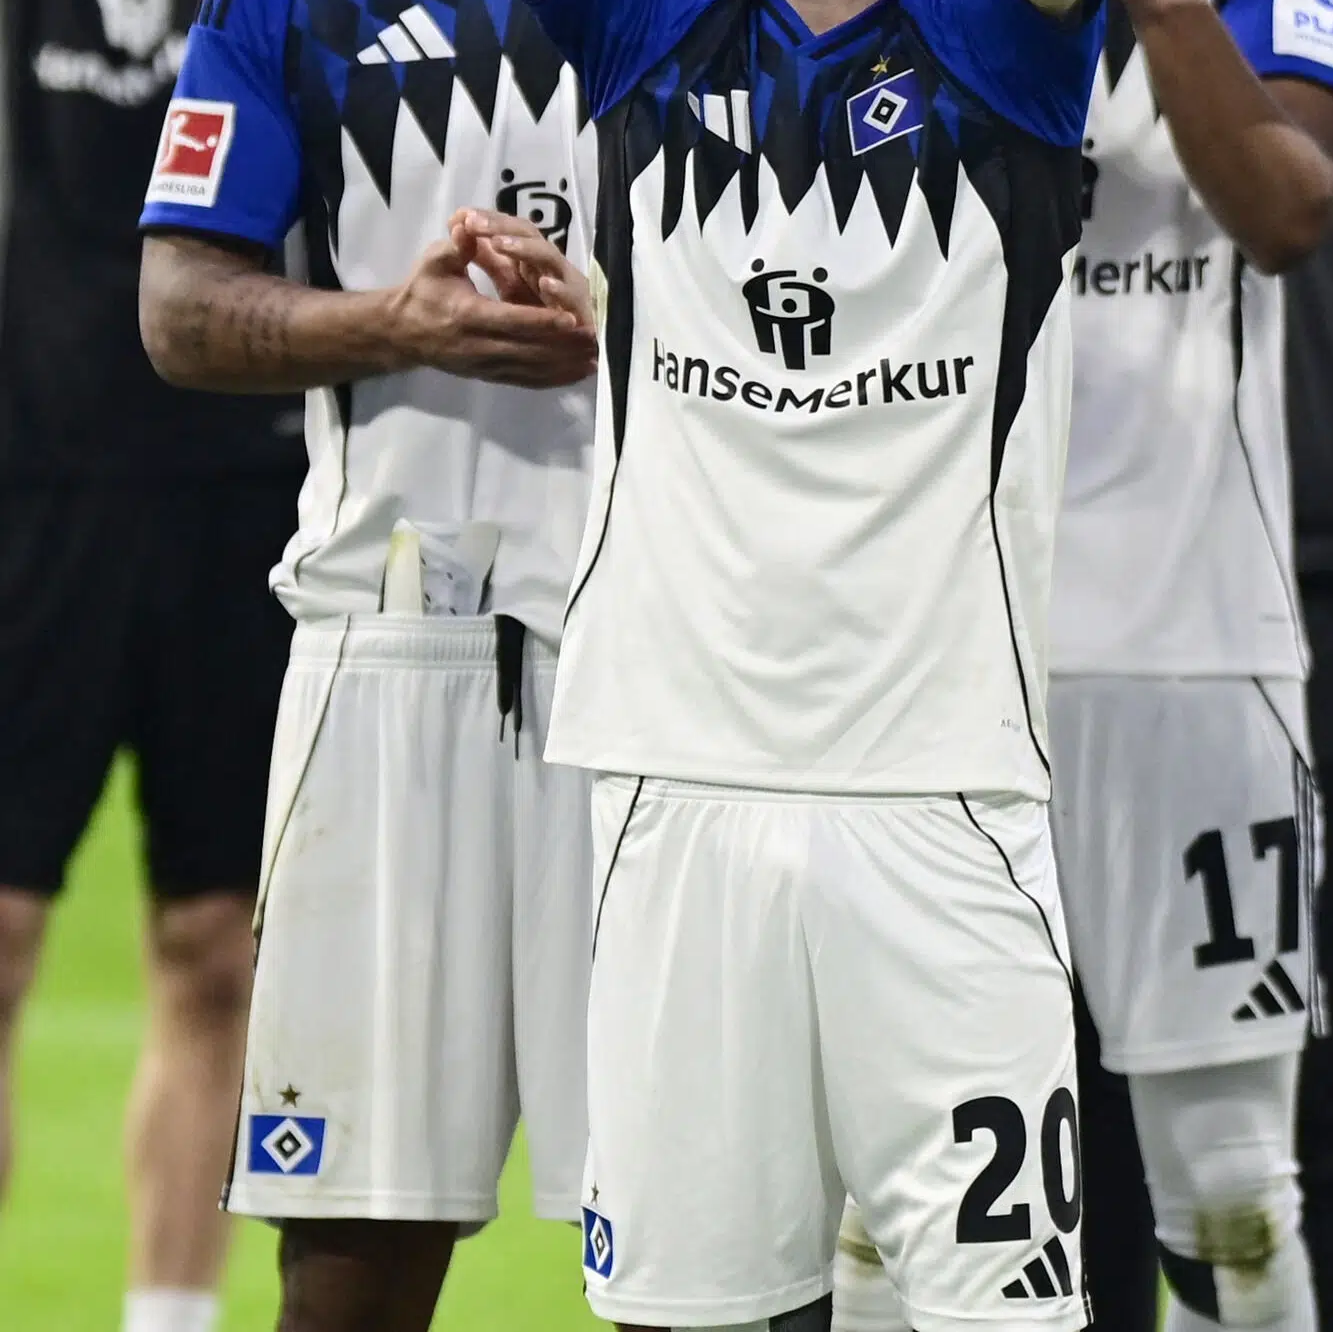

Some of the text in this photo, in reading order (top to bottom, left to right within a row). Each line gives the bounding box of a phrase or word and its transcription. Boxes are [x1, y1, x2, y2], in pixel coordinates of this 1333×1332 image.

[652, 337, 974, 413] HanseMerkur
[1183, 816, 1299, 970] 17
[952, 1086, 1081, 1245] 20
